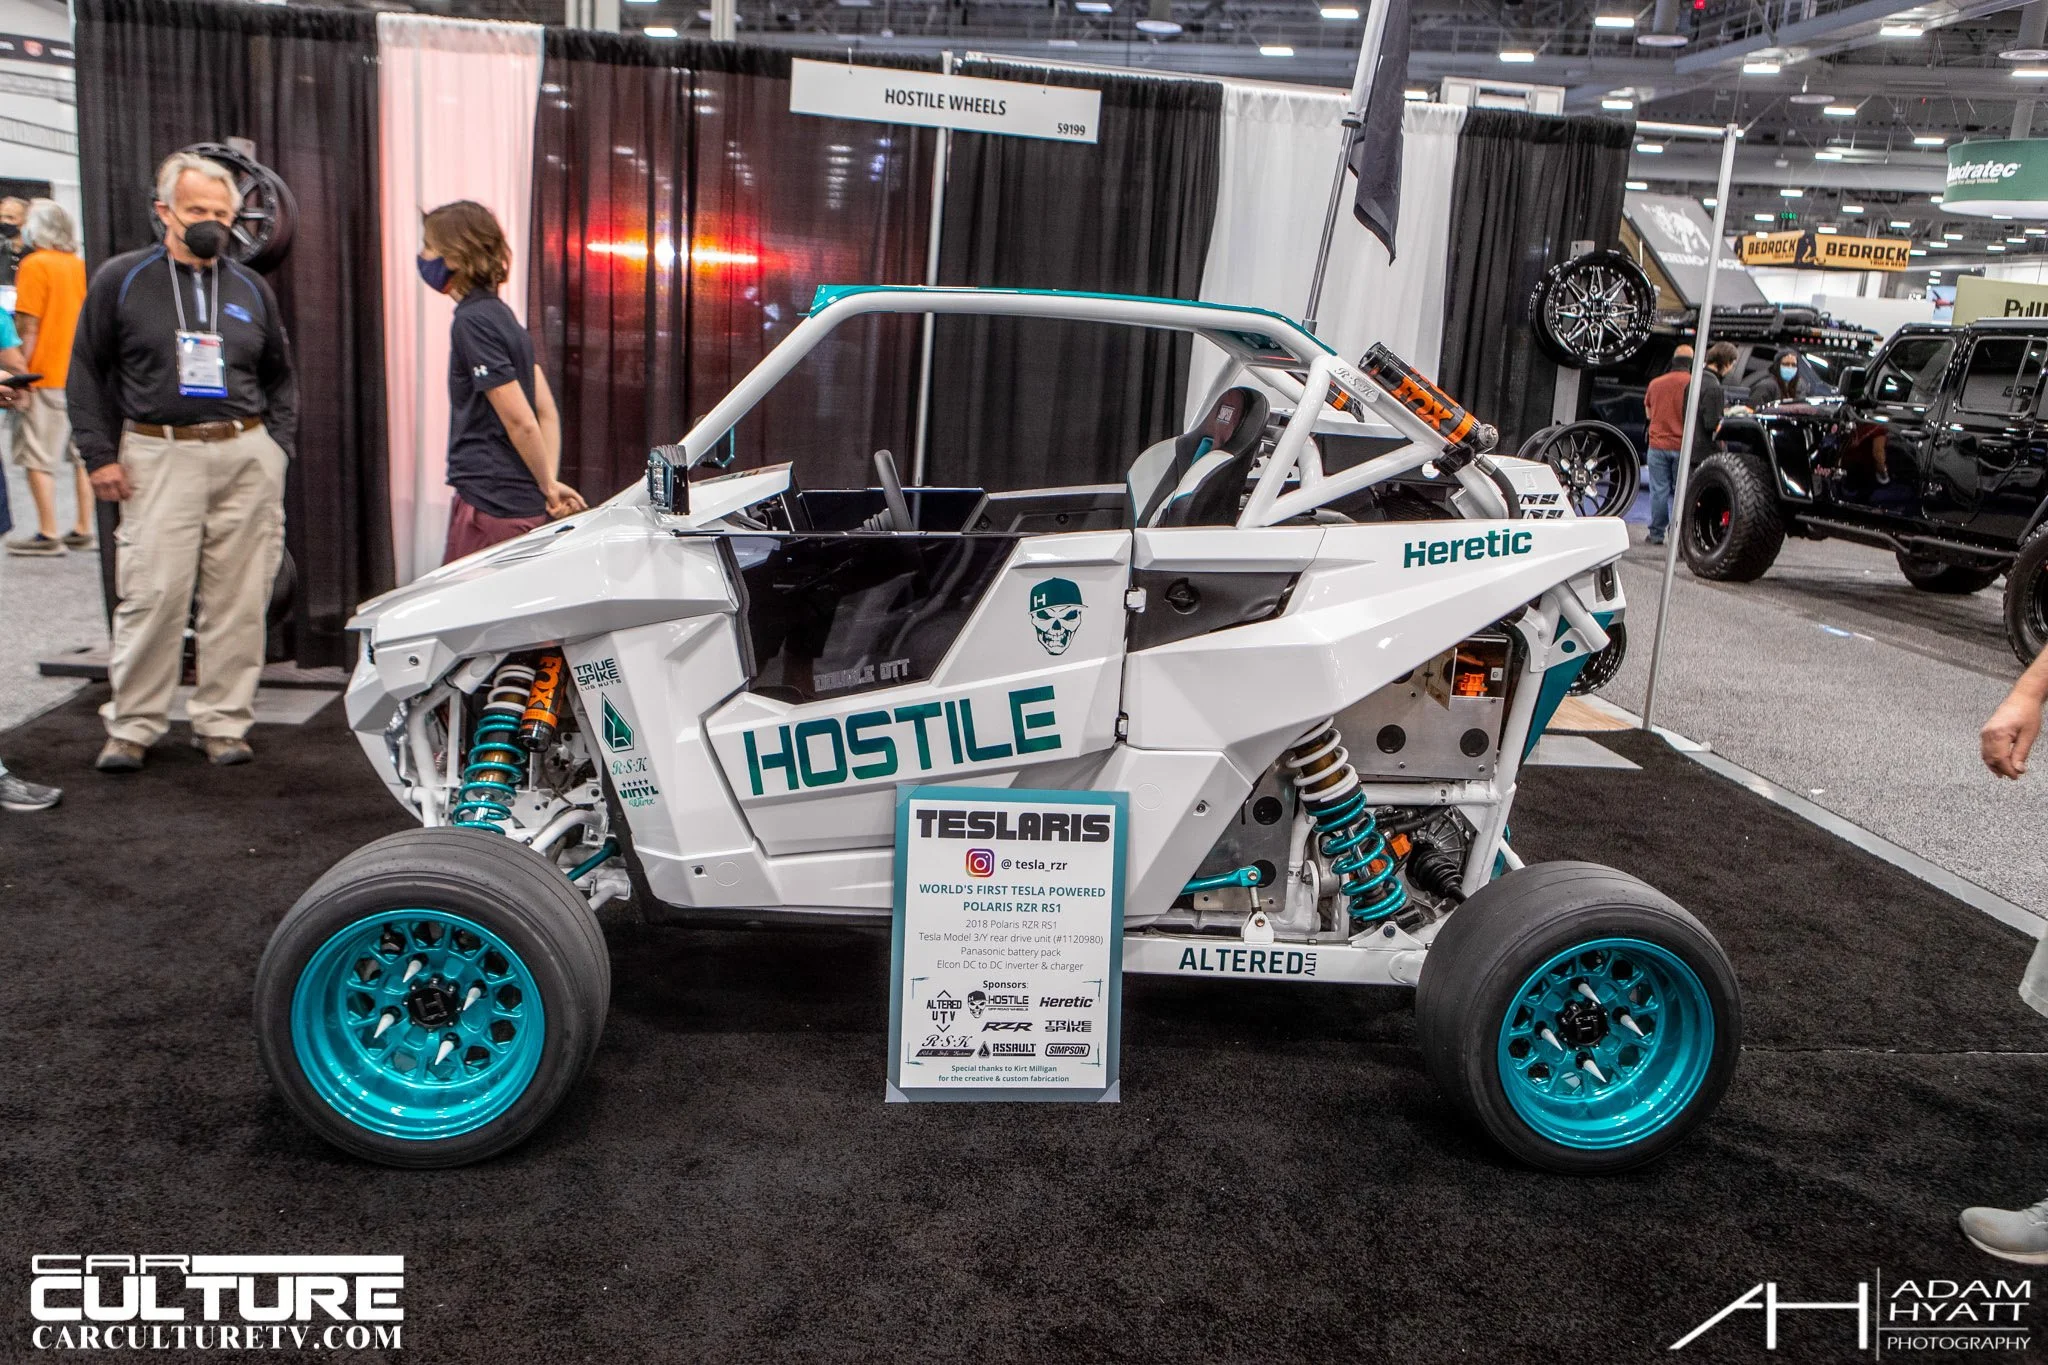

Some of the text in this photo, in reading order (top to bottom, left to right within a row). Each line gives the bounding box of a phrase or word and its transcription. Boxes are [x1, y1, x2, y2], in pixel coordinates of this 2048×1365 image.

[885, 88, 1007, 116] HOSTILE WHEELS
[1057, 122, 1086, 136] 59199
[1748, 239, 1796, 256] BEDROCK
[1826, 242, 1908, 261] BEDROCK
[1391, 376, 1454, 431] FOX
[1404, 529, 1532, 568] Heretic
[574, 658, 616, 676] TRUE
[528, 656, 562, 710] FOX
[577, 668, 619, 686] SPIKE
[598, 678, 622, 688] NUTS
[743, 685, 1062, 796] HOSTILE
[916, 809, 1111, 843] TESLARIS
[1001, 858, 1068, 873] @ tesla_rzr
[919, 883, 1106, 897] WORLD'S FIRST TESLA POWERED
[963, 901, 1062, 913] POLARIS RZR RS1
[965, 919, 1057, 929] 2018 Polaris RZR RS1
[919, 932, 941, 941] Tesla
[944, 932, 971, 942] Model
[973, 933, 988, 942] 3/Y
[1010, 933, 1032, 943] drive
[1034, 934, 1051, 943] unit
[1053, 934, 1104, 945] (#1120980)
[961, 946, 1061, 959] Panasonic battery pack
[937, 960, 1084, 973] Elcon DC to DC inverter & charger
[1178, 947, 1304, 975] ALTERED
[1304, 952, 1317, 976] UTV
[983, 980, 1029, 991] Sponsors:
[926, 999, 962, 1009] ALTERED
[988, 995, 1029, 1005] HOSTILE
[1039, 996, 1093, 1008] Heretic
[932, 1010, 956, 1024] UTV
[1045, 1019, 1092, 1027] TRUE
[981, 1021, 1034, 1032] RZR
[992, 1043, 1037, 1053] ASSAULT
[951, 1065, 976, 1074] Special
[978, 1065, 1002, 1073] thanks
[1014, 1065, 1027, 1073] Kirt
[1029, 1065, 1057, 1075] Milligan
[950, 1075, 963, 1083] the
[964, 1075, 993, 1083] creative
[995, 1075, 1001, 1083] &
[1002, 1075, 1029, 1083] custom
[1030, 1075, 1070, 1084] fabrication
